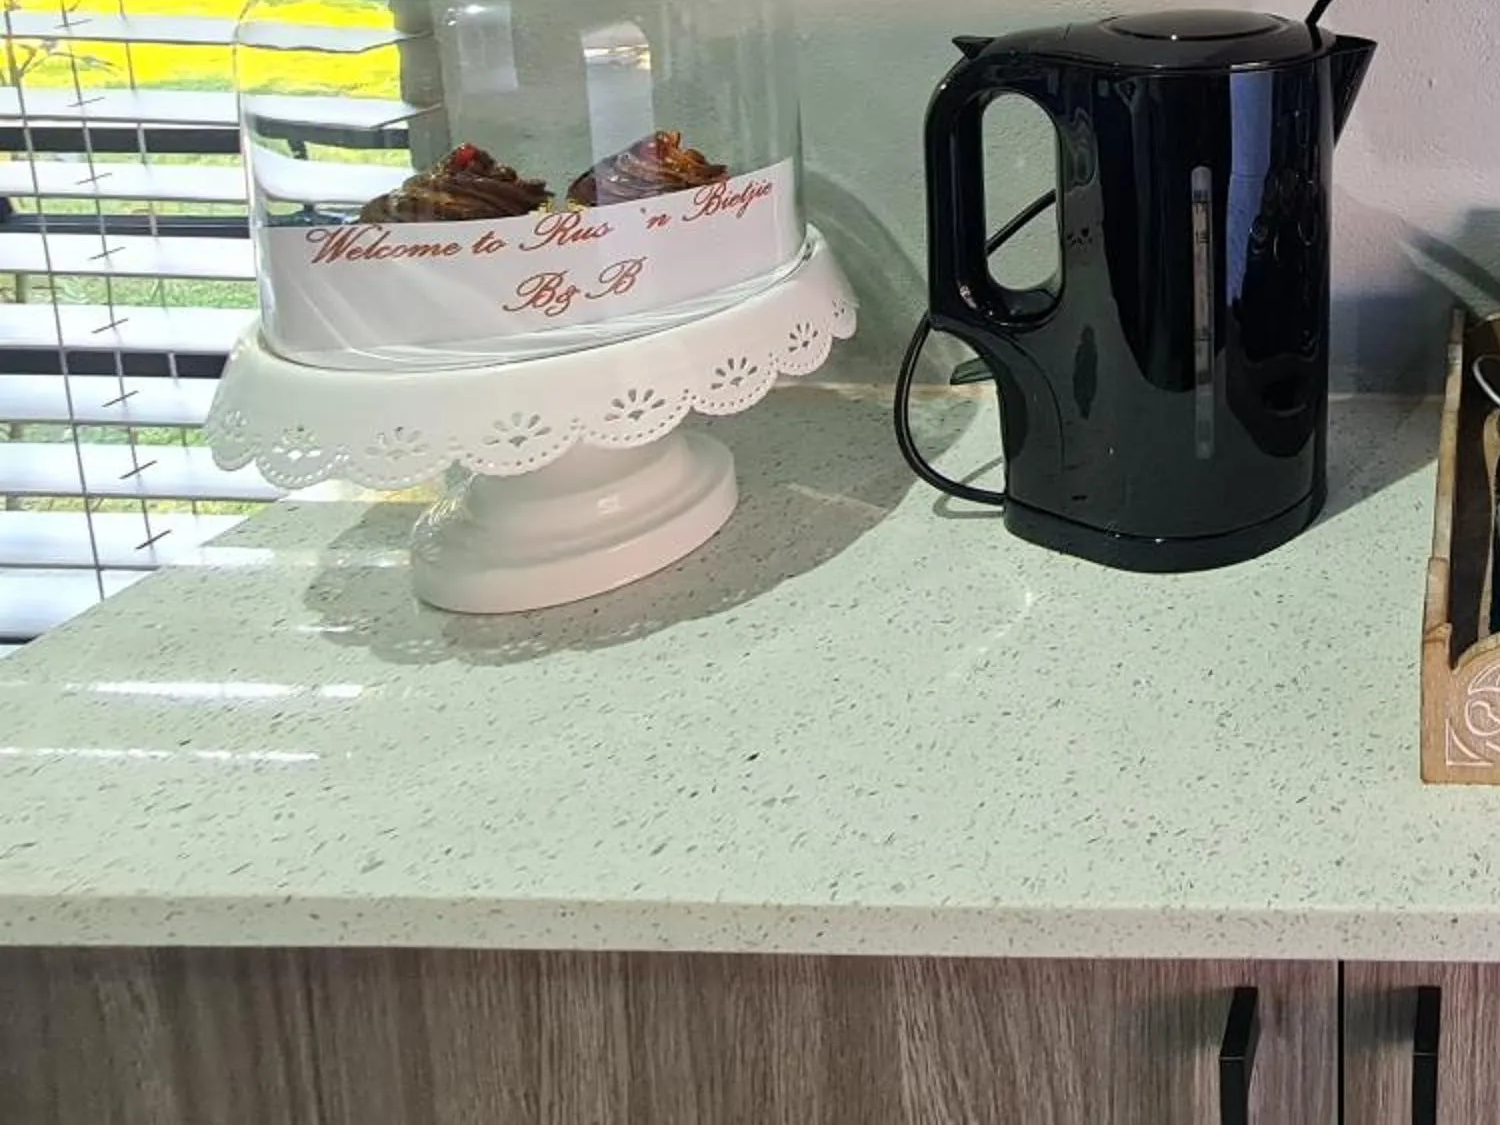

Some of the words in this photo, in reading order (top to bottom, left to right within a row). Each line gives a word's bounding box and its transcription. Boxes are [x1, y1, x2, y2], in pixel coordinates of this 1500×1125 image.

[305, 225, 463, 264] Welcome
[471, 230, 507, 255] to
[518, 212, 615, 252] Rus
